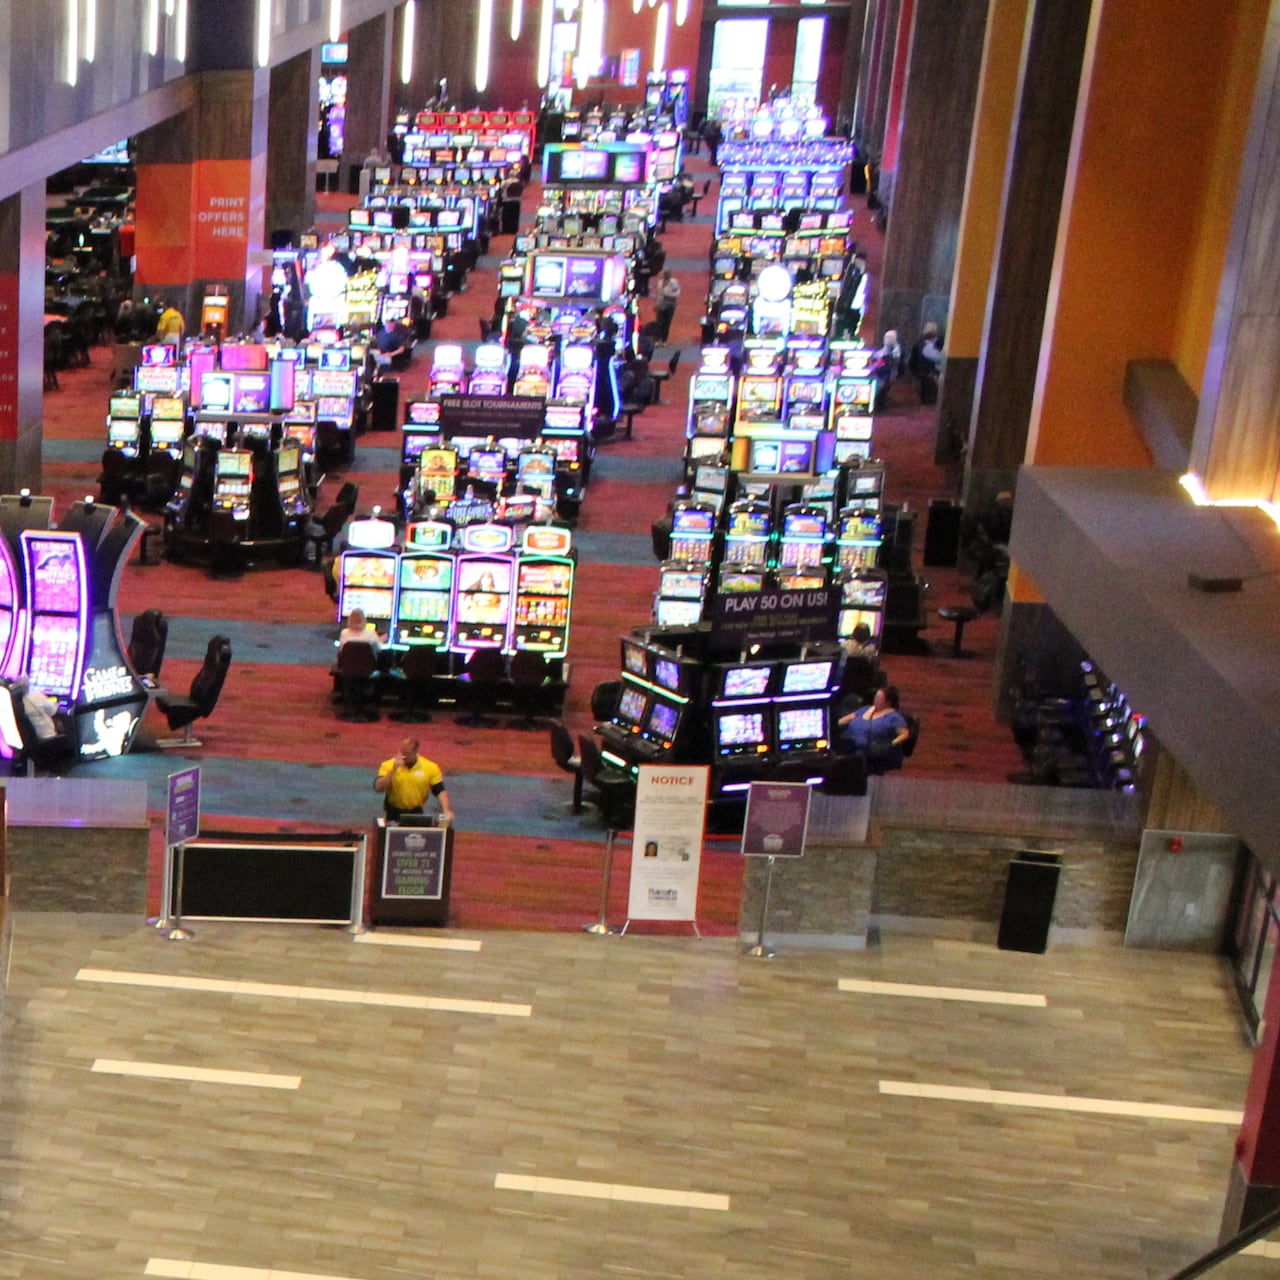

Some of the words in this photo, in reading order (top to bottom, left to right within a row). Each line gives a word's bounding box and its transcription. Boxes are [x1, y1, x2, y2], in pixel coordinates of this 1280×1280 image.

[209, 196, 244, 208] PRINT
[198, 211, 244, 222] OFFERS
[212, 226, 243, 237] HERE
[443, 400, 460, 408] FREE
[462, 400, 481, 409] SLOT
[483, 400, 543, 411] TOURNAMENTS
[724, 596, 758, 613] PLAY
[760, 595, 778, 610] 50
[780, 594, 804, 609] ON
[651, 776, 694, 786] NOTICE
